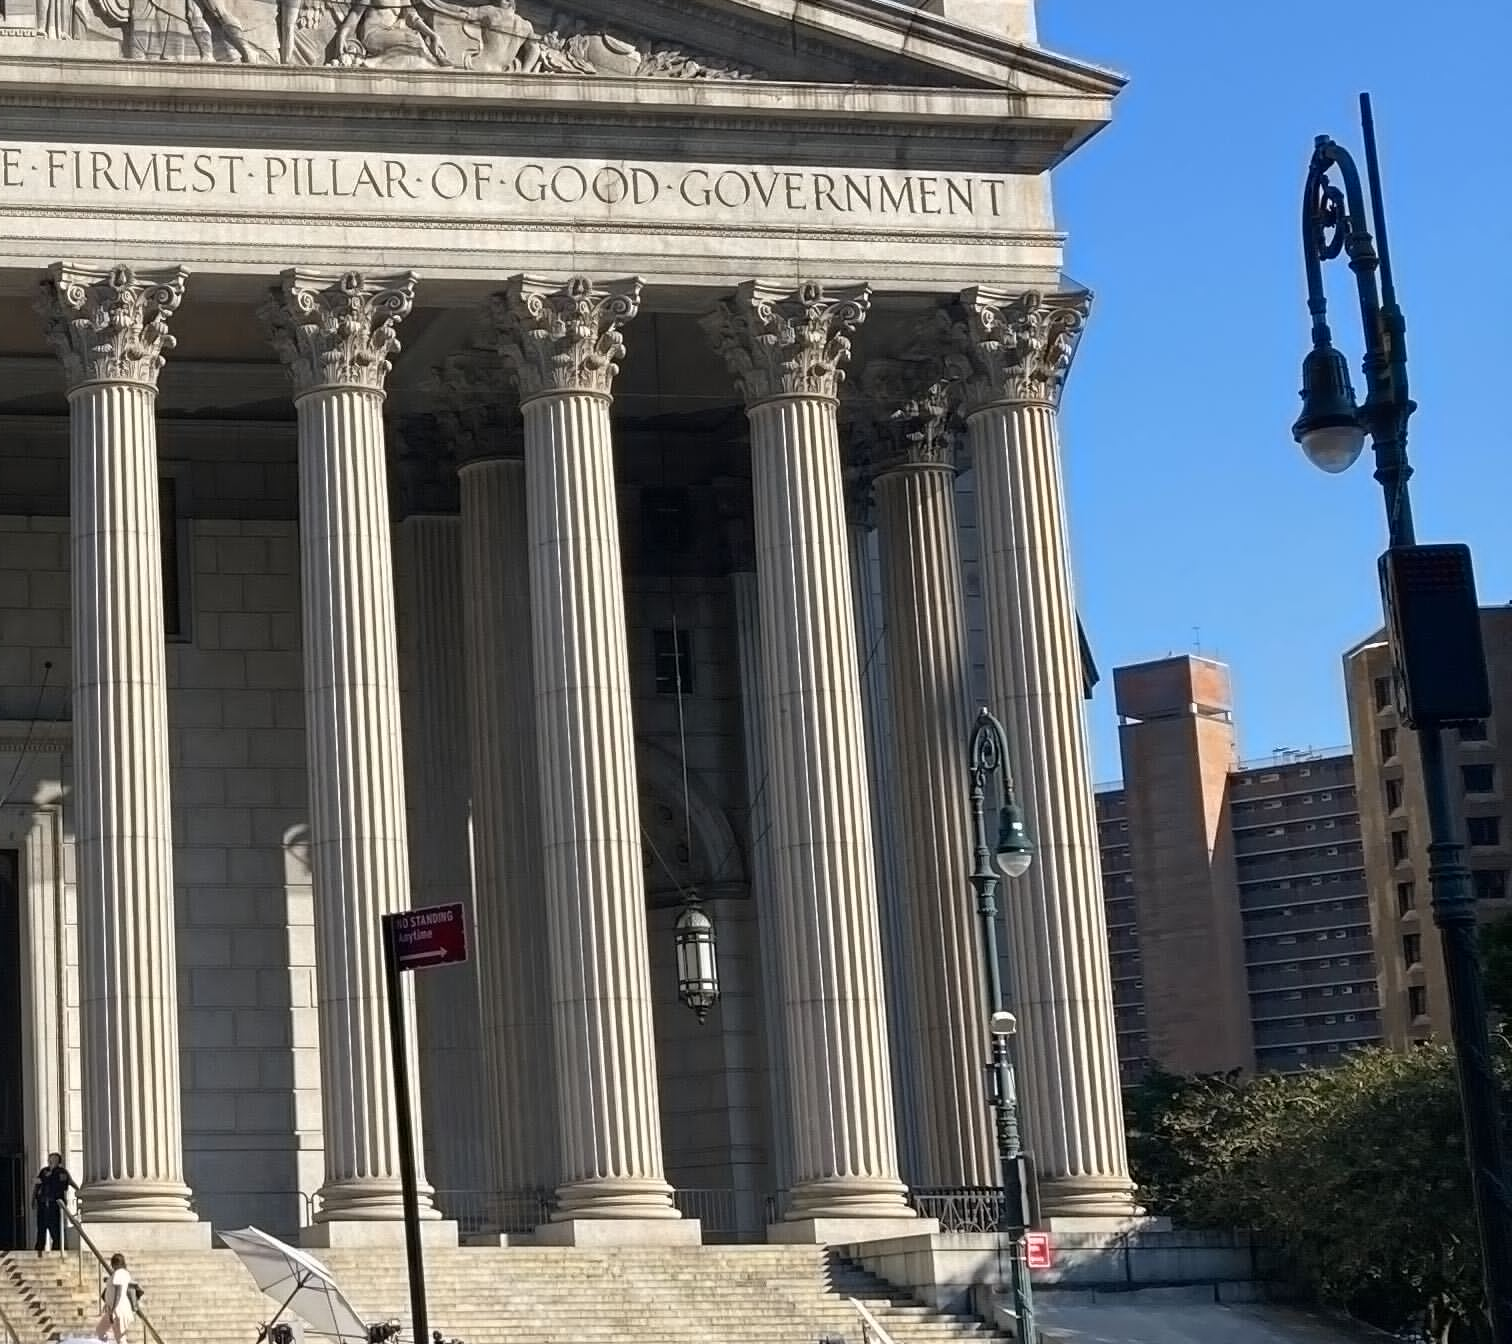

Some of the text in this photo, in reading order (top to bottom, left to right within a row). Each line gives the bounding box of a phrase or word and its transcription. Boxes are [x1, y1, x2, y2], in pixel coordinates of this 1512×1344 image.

[45, 149, 244, 193] FIRMEST
[263, 157, 419, 199] PILLAR
[431, 161, 493, 201] OF
[514, 164, 659, 206] GOOD
[679, 169, 1006, 216] GOVERNMENT
[410, 910, 454, 927] STANDING
